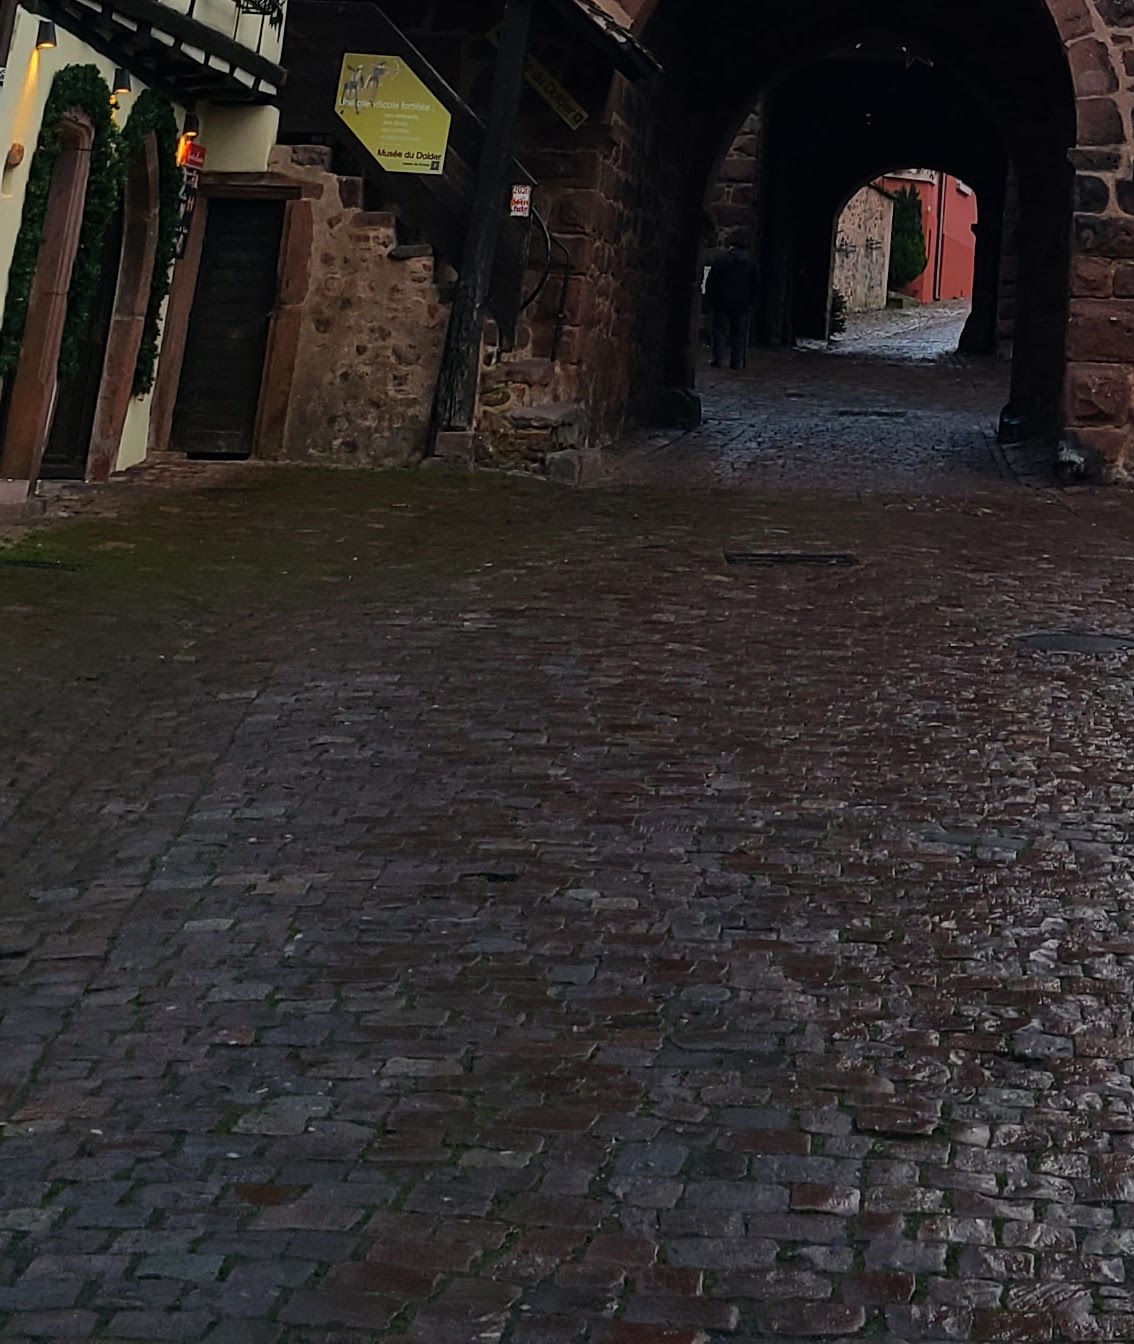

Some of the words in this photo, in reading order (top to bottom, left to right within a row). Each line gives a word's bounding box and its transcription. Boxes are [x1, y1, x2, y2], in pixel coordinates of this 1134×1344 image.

[377, 149, 403, 159] Musée
[404, 151, 415, 160] du
[416, 151, 442, 161] Dolder
